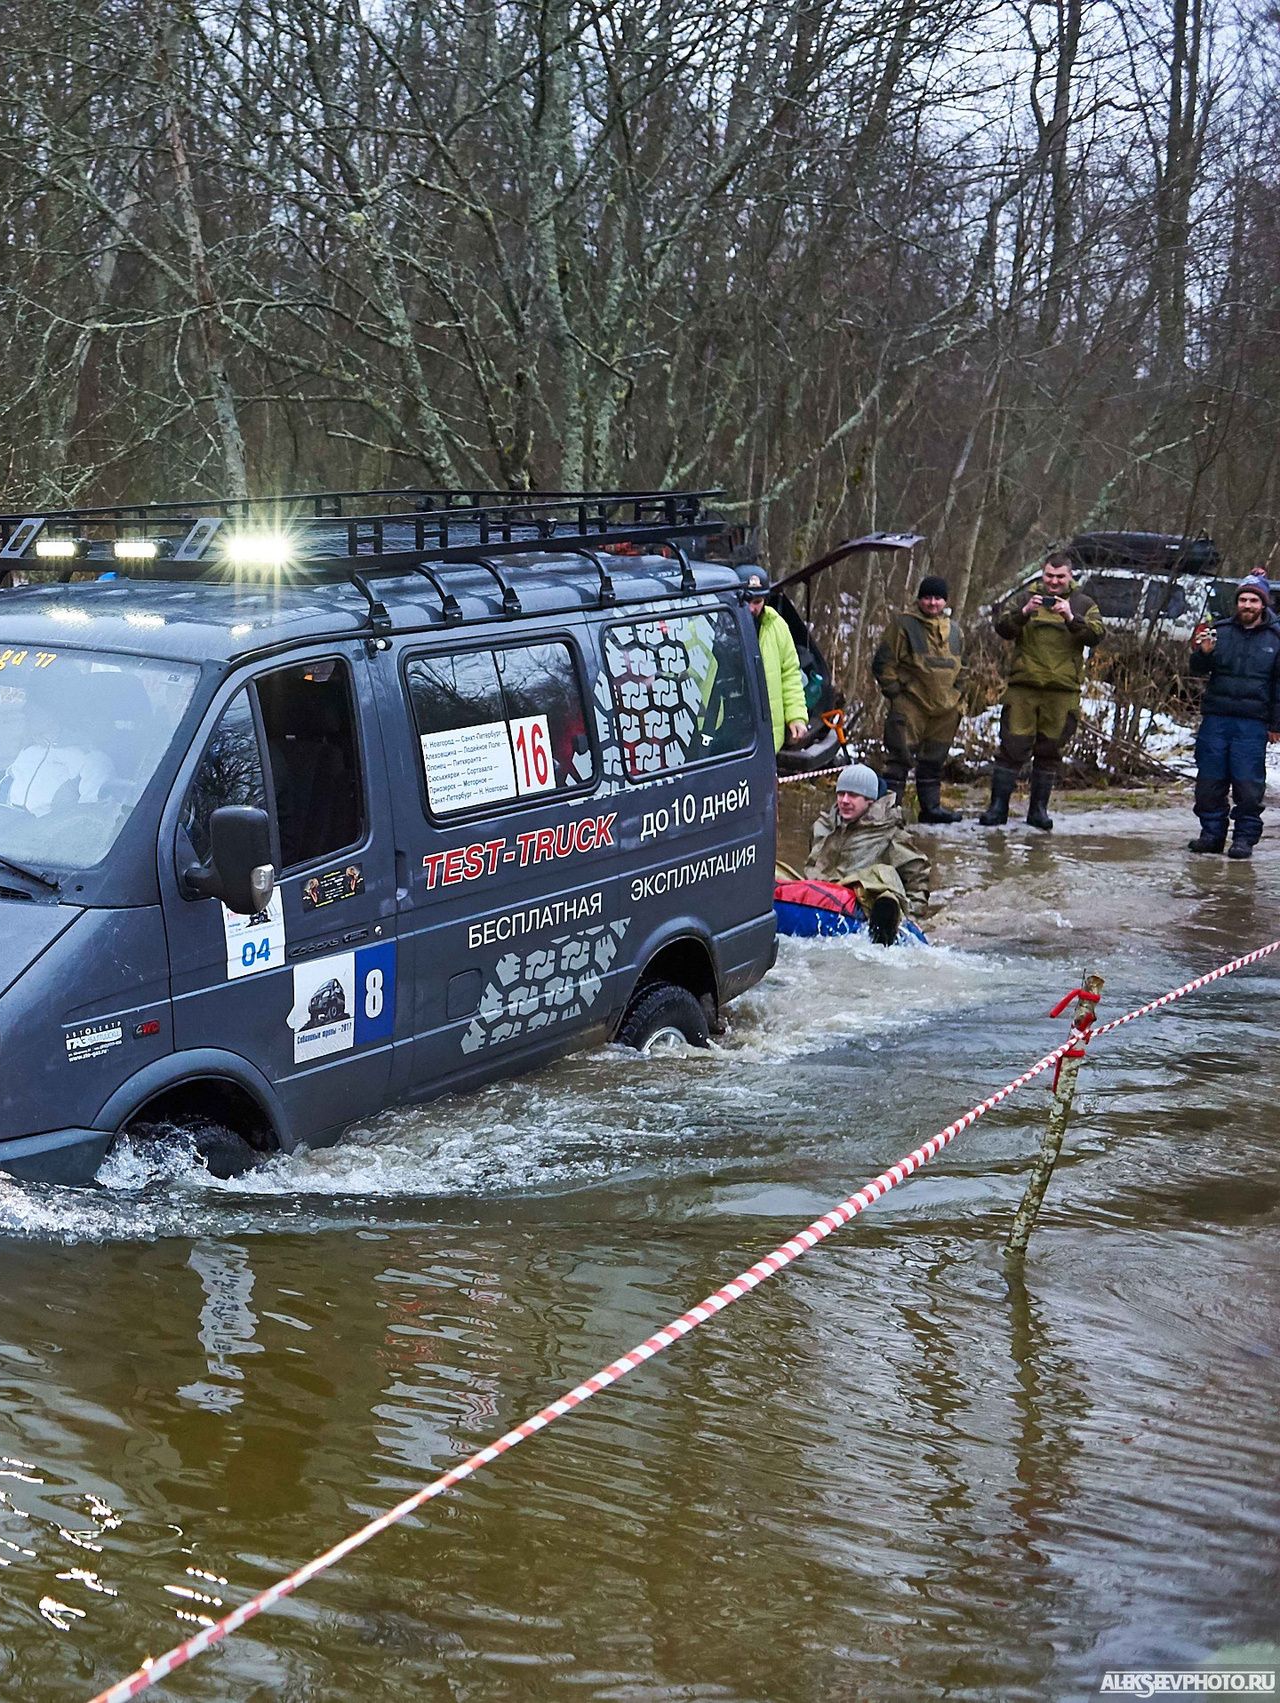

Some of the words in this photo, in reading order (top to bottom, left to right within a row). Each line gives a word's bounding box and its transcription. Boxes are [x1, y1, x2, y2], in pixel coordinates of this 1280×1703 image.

[430, 738, 454, 748] Новгород
[461, 730, 502, 743] Санкт-Петербург
[488, 741, 501, 749] Поле
[467, 764, 493, 776] Сортавала
[516, 723, 549, 787] 16
[429, 784, 456, 794] Приозерск
[431, 792, 472, 805] Санкт-Петербург
[485, 784, 509, 794] Новгород
[640, 808, 669, 841] до
[671, 793, 696, 824] 10
[700, 780, 750, 824] дней
[422, 811, 618, 890] TEST-TRUCK
[468, 892, 602, 949] БЕСПЛАТНАЯ
[630, 844, 756, 902] ЭКСПЛУАТАЦИЯ
[242, 937, 271, 967] 04
[365, 968, 384, 1019] 8
